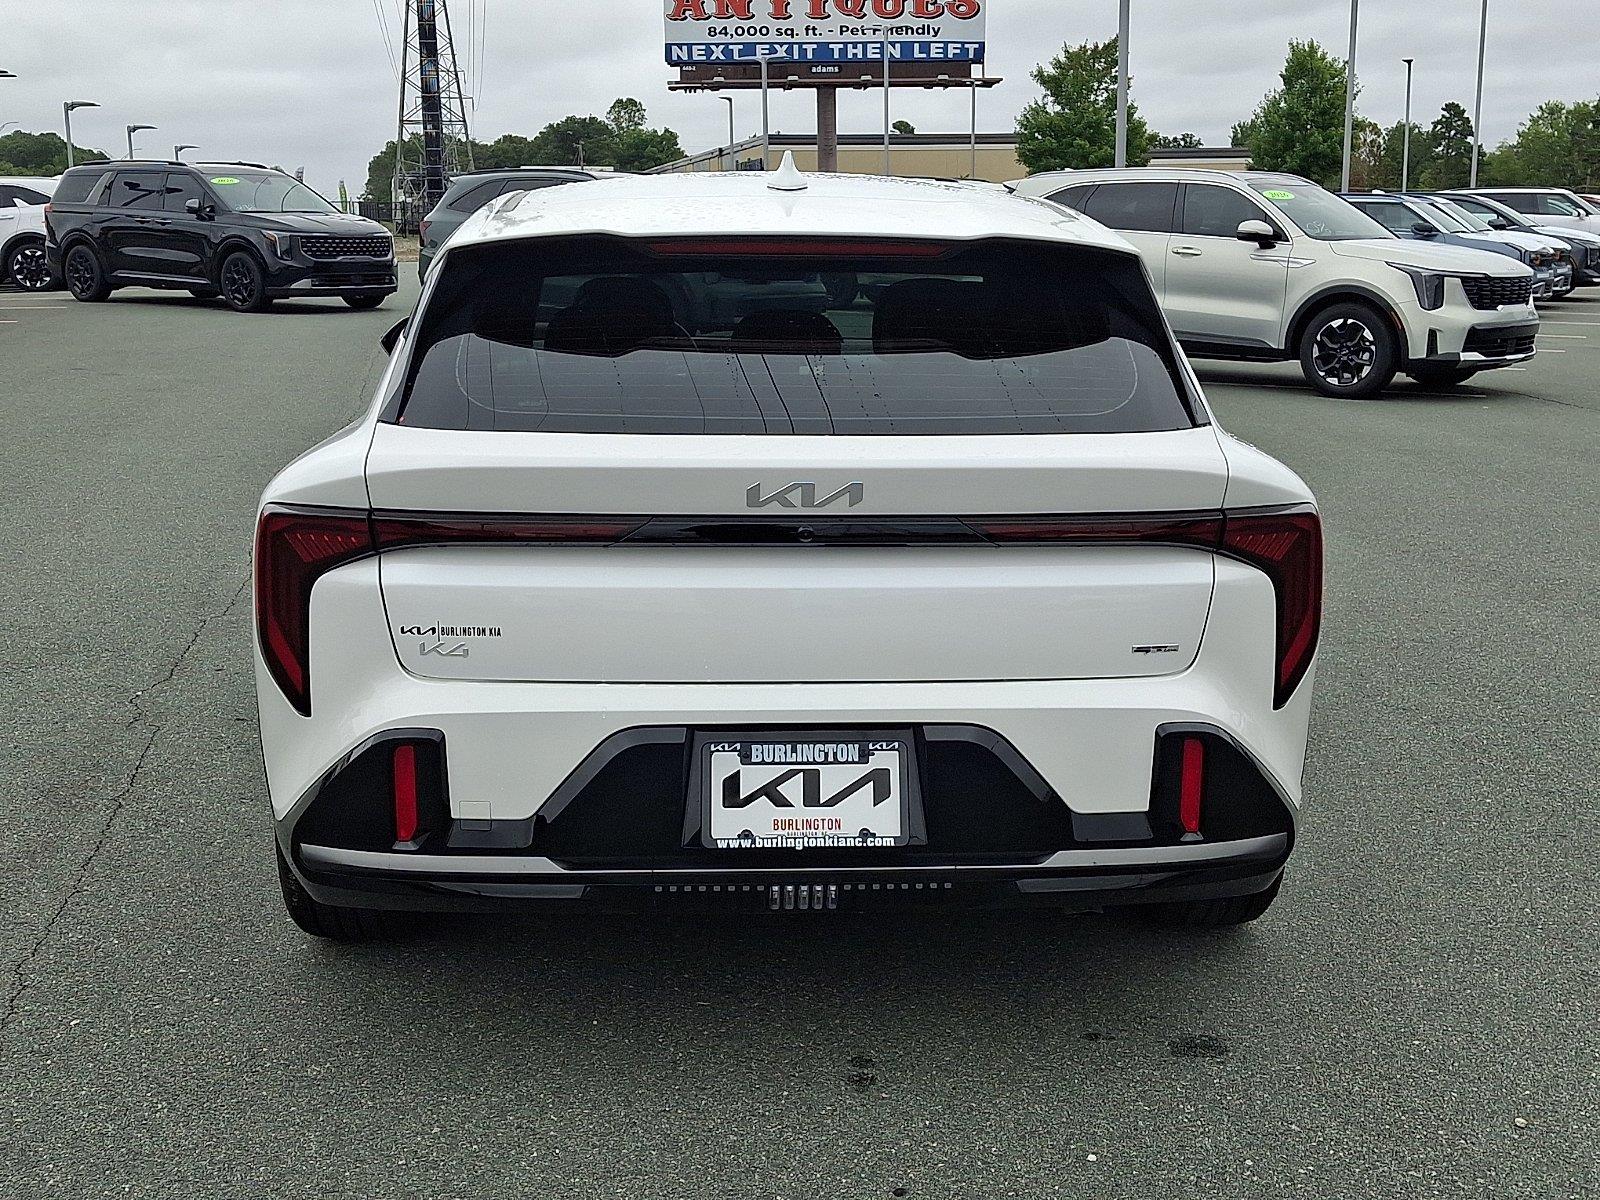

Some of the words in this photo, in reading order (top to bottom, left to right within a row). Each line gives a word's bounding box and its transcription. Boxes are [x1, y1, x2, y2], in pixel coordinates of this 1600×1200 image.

[707, 26, 770, 39] 84,000
[775, 28, 800, 39] sq.
[805, 25, 823, 37] ft.
[839, 25, 867, 36] Pet
[671, 44, 744, 61] NEXT
[756, 44, 818, 60] EXIT
[829, 43, 901, 59] THEN
[913, 42, 980, 59] LEFT
[811, 65, 840, 73] adams
[746, 481, 864, 508] KIA
[440, 626, 487, 637] BURLINGTON
[488, 627, 502, 637] KIA
[419, 641, 469, 658] K4
[751, 743, 859, 763] BURLINGTON
[722, 768, 892, 809] KIA
[773, 818, 842, 831] BURLINGTON
[716, 834, 895, 850] www.burlingtonkianc.com
